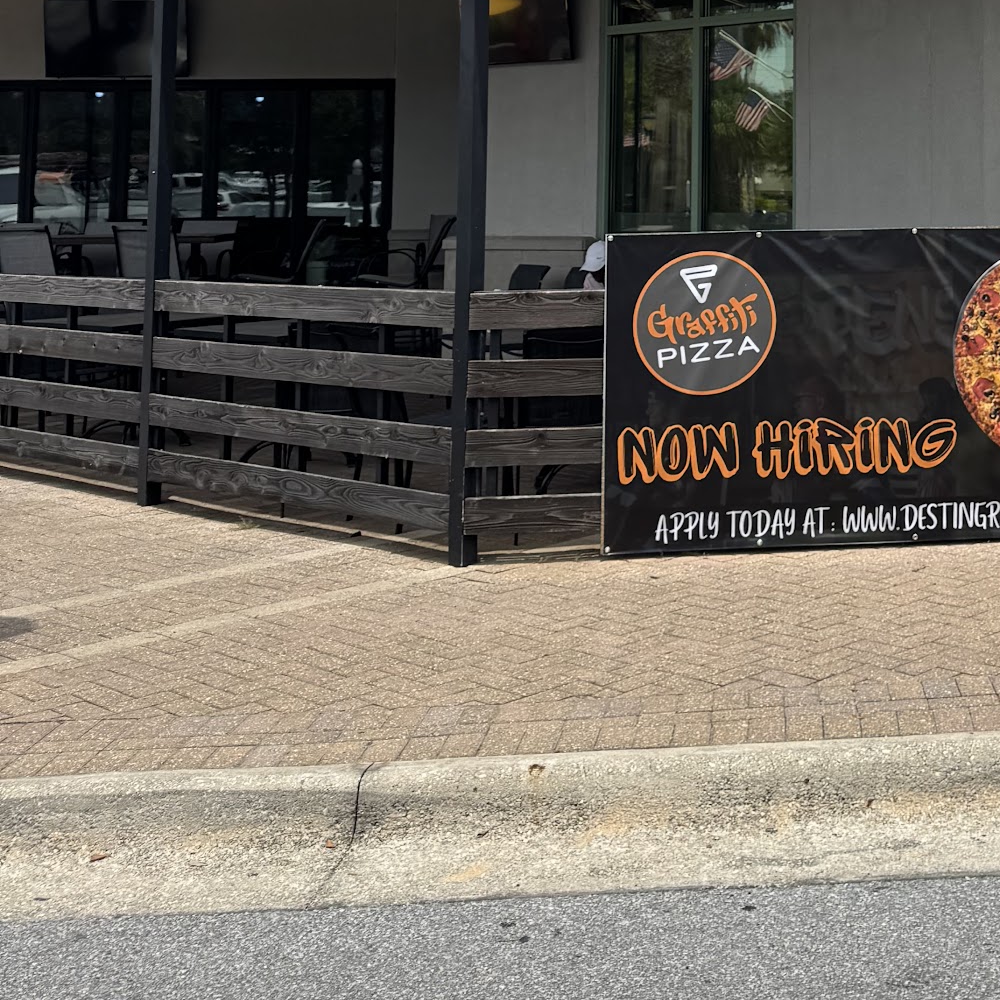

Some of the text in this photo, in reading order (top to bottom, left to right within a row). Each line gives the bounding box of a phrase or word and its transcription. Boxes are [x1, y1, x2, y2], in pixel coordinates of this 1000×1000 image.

[647, 293, 758, 345] Graffiti
[656, 335, 760, 369] PIZZA
[617, 421, 740, 485] NOW
[655, 511, 720, 545] APPLY
[726, 507, 796, 540] TODAY
